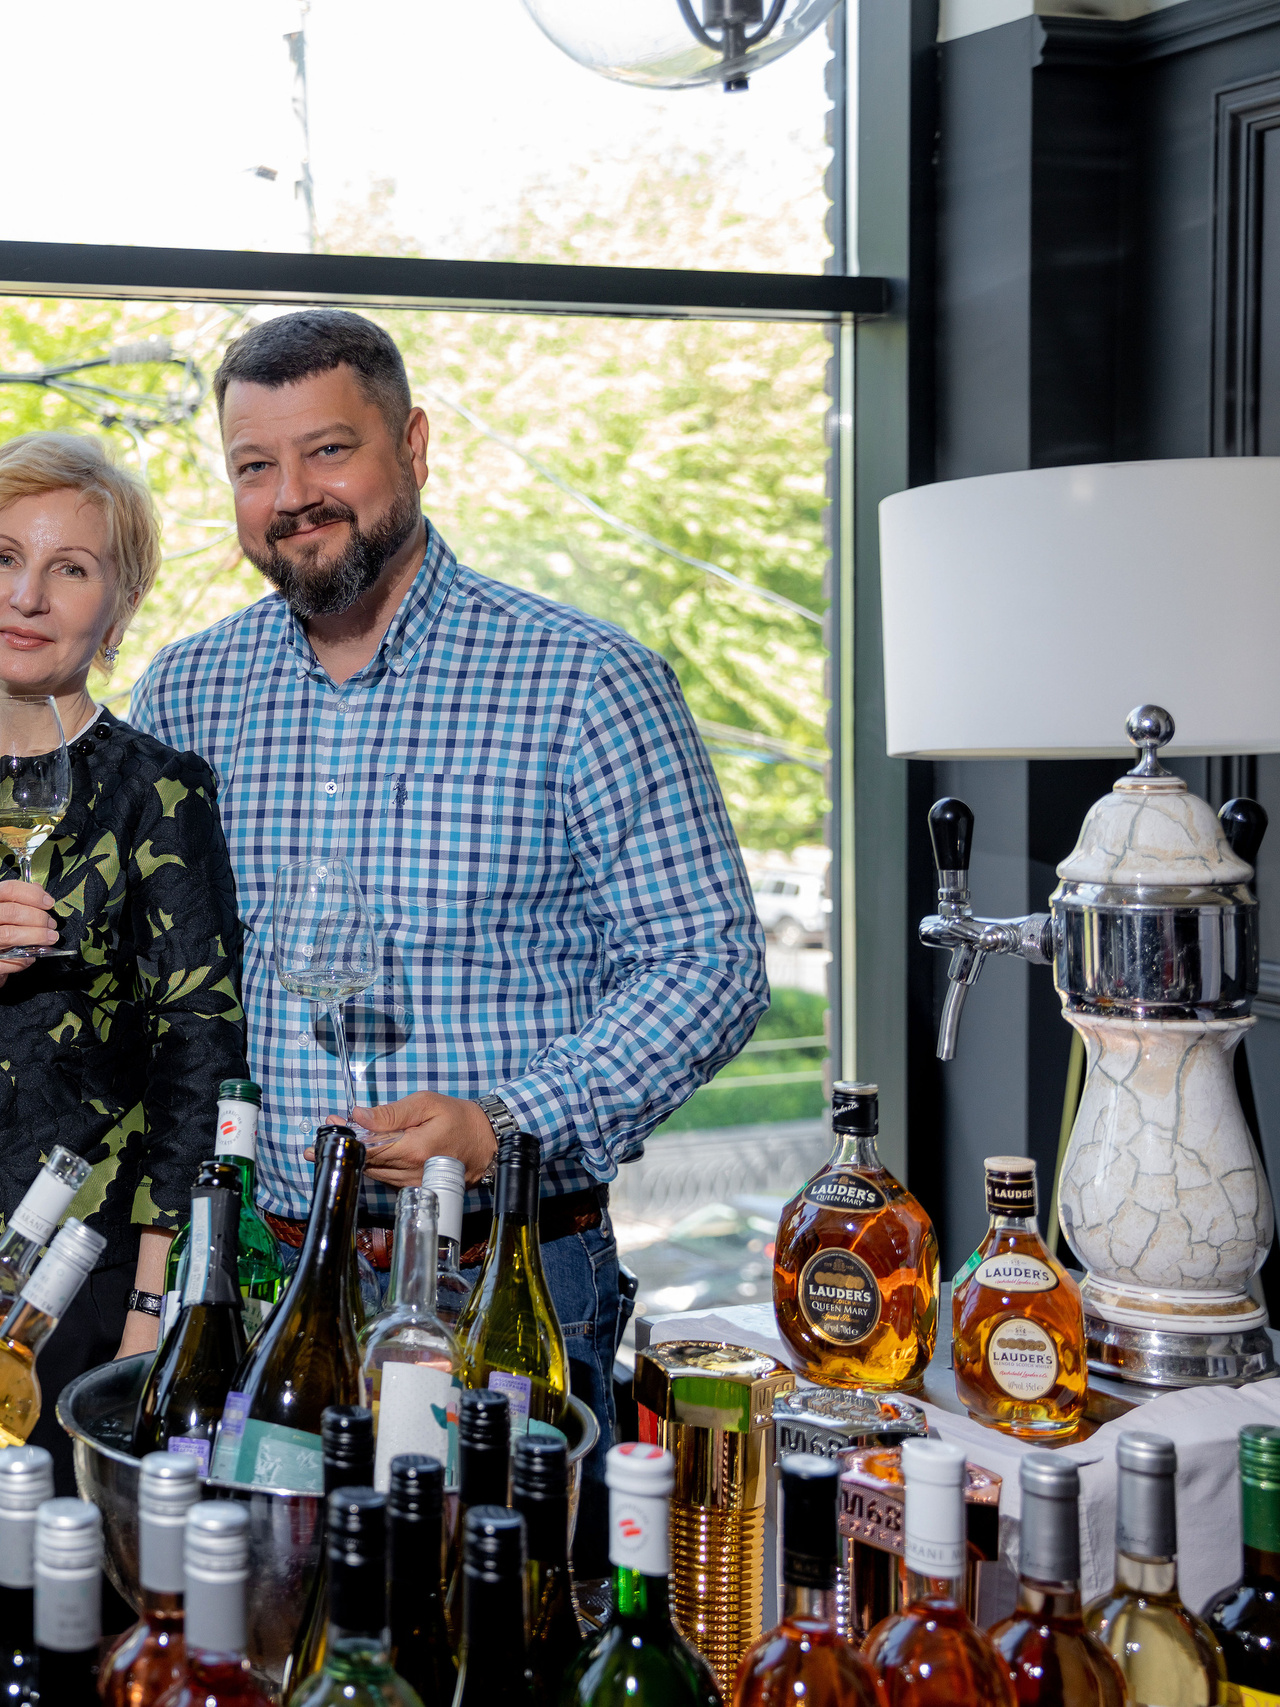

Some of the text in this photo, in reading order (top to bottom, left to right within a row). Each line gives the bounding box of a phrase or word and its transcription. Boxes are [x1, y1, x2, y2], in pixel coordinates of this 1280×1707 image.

[810, 1184, 876, 1203] LAUDER'S
[816, 1193, 864, 1207] QUEEN MARY
[985, 1267, 1050, 1281] LAUDER'S
[808, 1284, 872, 1303] LAUDER'S
[811, 1300, 869, 1316] QUEEN MARY
[993, 1352, 1053, 1365] LAUDER'S
